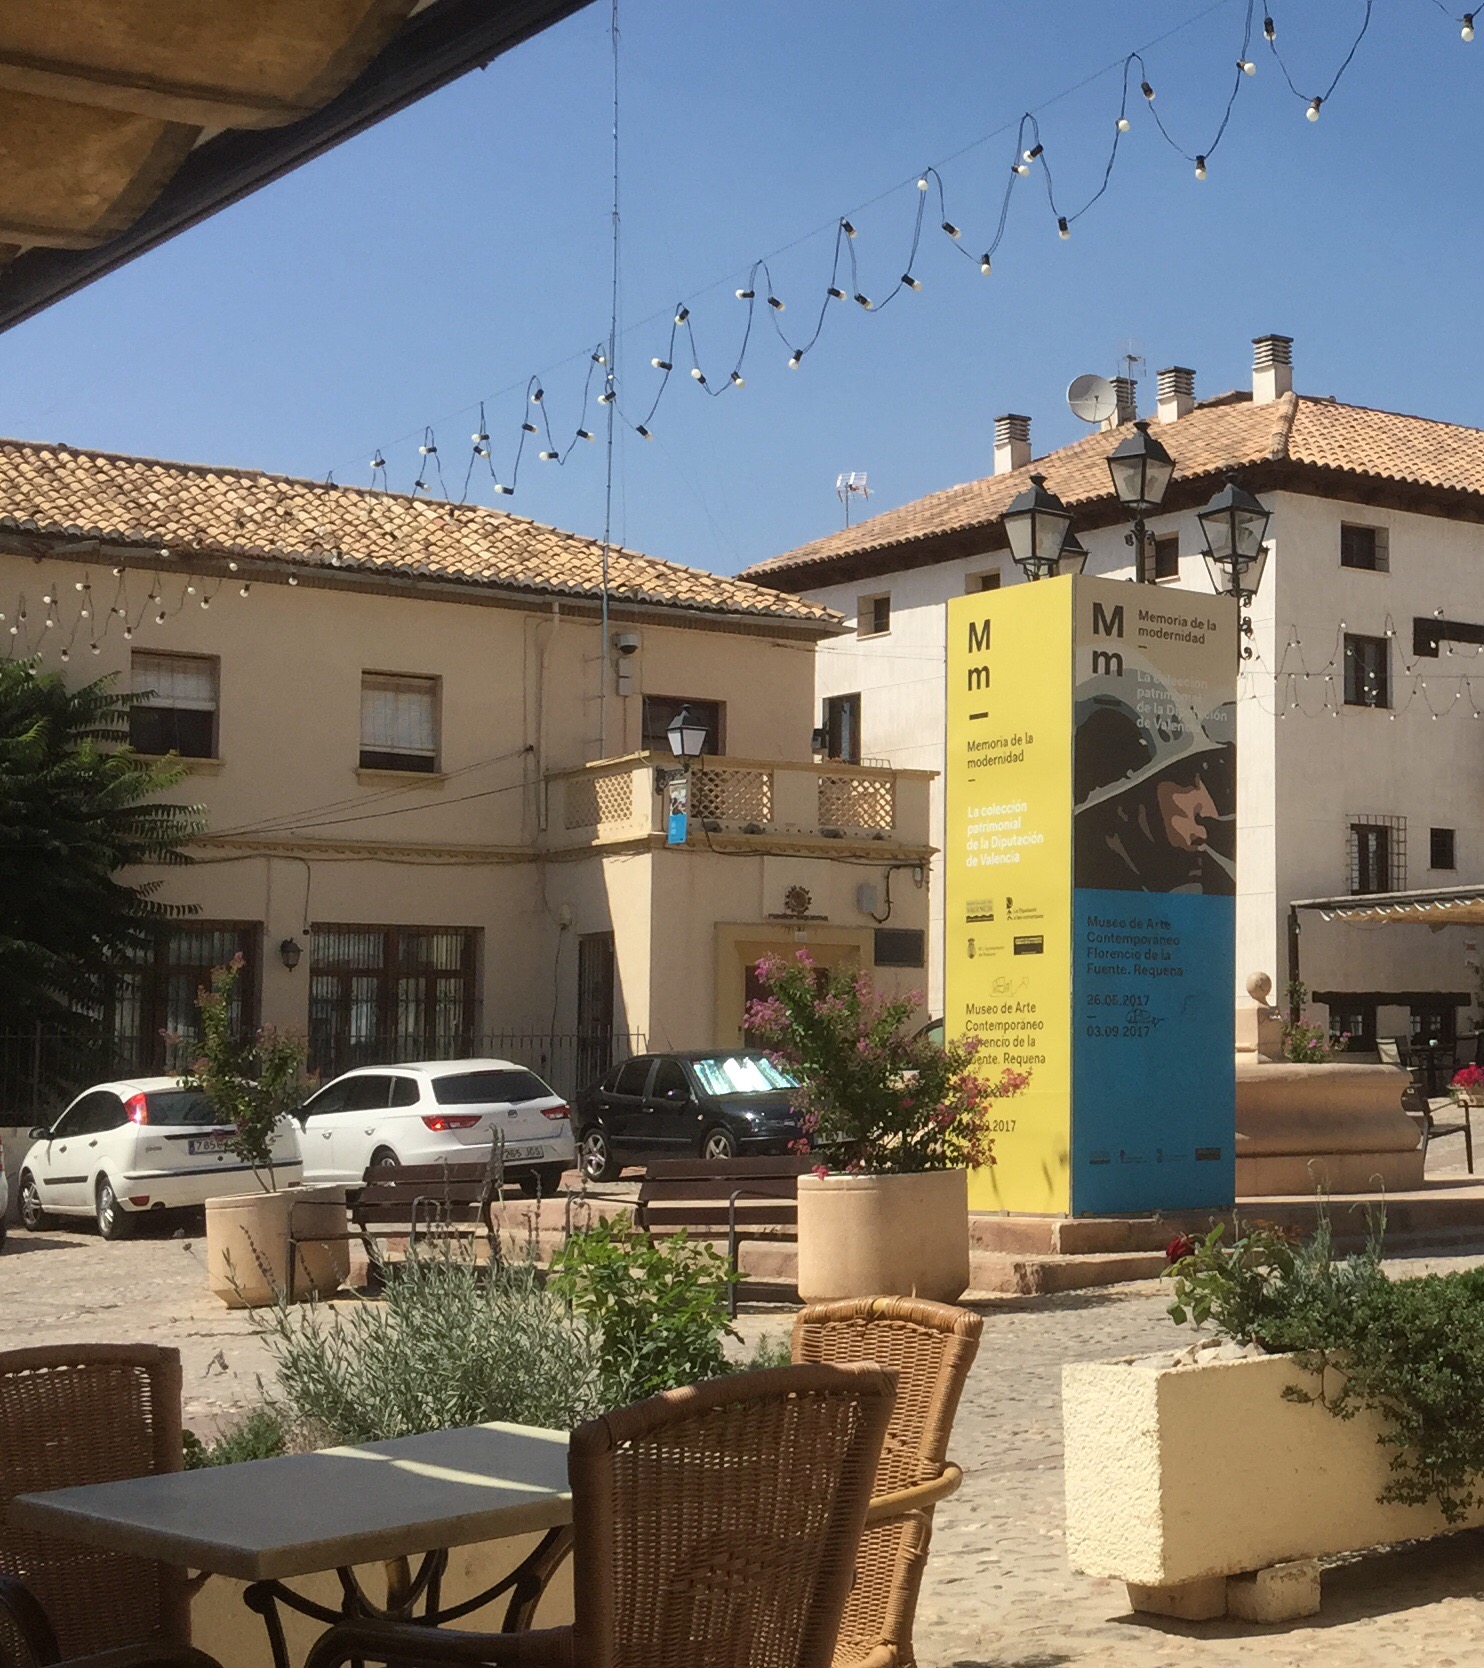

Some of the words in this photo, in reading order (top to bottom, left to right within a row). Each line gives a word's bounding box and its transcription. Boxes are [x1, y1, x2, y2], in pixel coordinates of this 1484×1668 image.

[1092, 601, 1124, 639] M
[1137, 609, 1188, 627] Memoria
[1190, 617, 1205, 630] de
[1207, 619, 1217, 631] la
[968, 618, 991, 654] M
[1137, 626, 1206, 645] modernidad
[1092, 649, 1124, 678] m
[967, 665, 990, 691] m
[1136, 700, 1152, 714] de
[1153, 702, 1164, 716] la
[1136, 715, 1151, 729] de
[967, 735, 1009, 752] Memoria
[1010, 733, 1023, 747] de
[1025, 731, 1034, 745] la
[967, 749, 1025, 769] modernidad
[967, 806, 980, 819] La
[981, 799, 1027, 817] colección
[967, 816, 1023, 837] patrimonial
[966, 839, 979, 851] de
[980, 836, 990, 850] la
[991, 831, 1044, 850] Diputación
[966, 855, 979, 868] de
[980, 850, 1021, 867] Valencia
[1087, 915, 1127, 929] Museo
[1129, 917, 1144, 929] de
[1146, 918, 1172, 931] Arte
[1086, 946, 1141, 960] Florencio
[1144, 948, 1159, 960] de
[1161, 949, 1171, 961] la
[1086, 962, 1131, 975] Fuente.
[1133, 963, 1184, 979] Requena
[965, 1003, 998, 1015] Museo
[1000, 1002, 1013, 1015] de
[1015, 1001, 1037, 1014] Arte
[1086, 993, 1150, 1007] 26.05.2017
[1012, 1035, 1025, 1048] de
[1027, 1034, 1036, 1048] la
[1003, 1052, 1046, 1067] Requena
